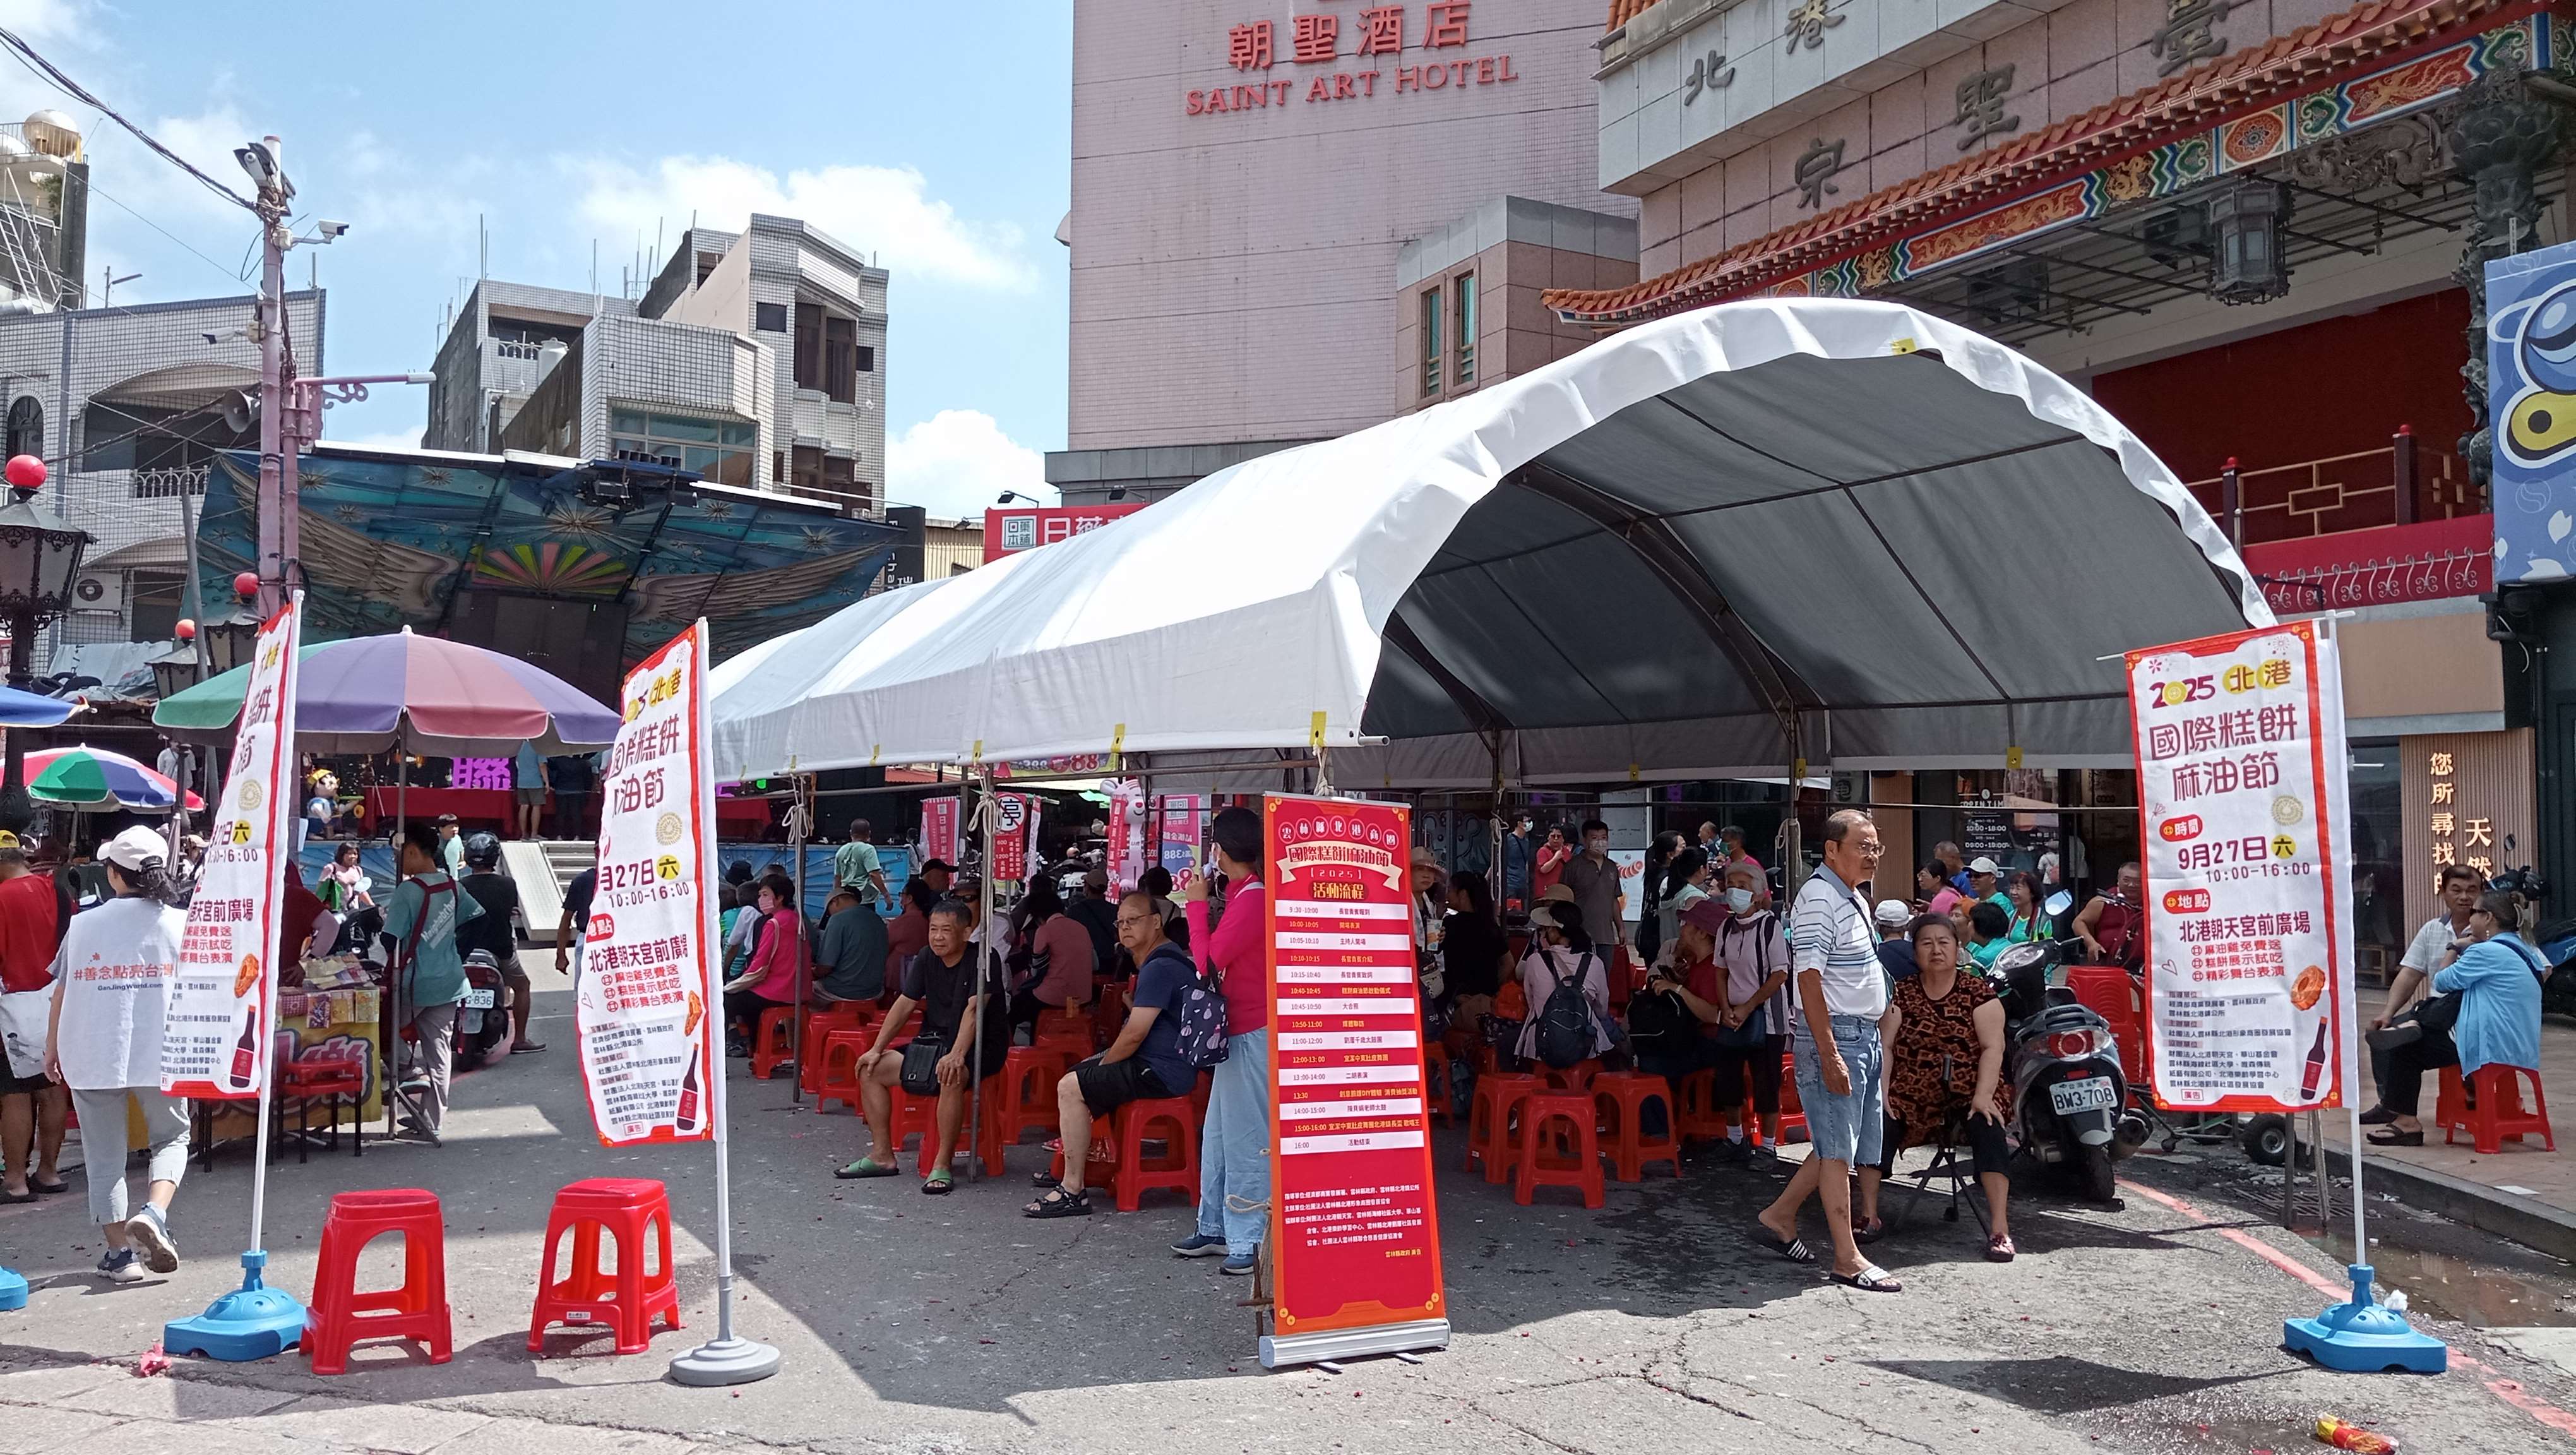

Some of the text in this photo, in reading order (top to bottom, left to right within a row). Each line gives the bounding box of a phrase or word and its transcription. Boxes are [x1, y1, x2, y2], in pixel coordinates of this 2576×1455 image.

[1228, 0, 1472, 71] 朝聖酒店
[1684, 0, 1846, 107] 北港
[1186, 54, 1519, 116] SAINT ART HOTEL
[2229, 660, 2292, 692] 北港
[2149, 704, 2298, 760] 國際糕餅
[2173, 751, 2279, 802] 麻油節
[612, 767, 665, 818] 油節
[2174, 820, 2200, 836] 時間
[2178, 836, 2294, 870] 9月27日 六
[600, 858, 655, 892] 月27日
[2205, 862, 2310, 883] 10:00-16:00
[608, 882, 689, 908] 10:00-16:00
[1313, 882, 1364, 900] 活動流程
[2177, 893, 2209, 909] 地點
[2179, 911, 2311, 943] 北港朝天宮前廣場
[2205, 939, 2282, 955] 麻油雞免費送
[2205, 952, 2284, 967] 糕餅展示試吃
[73, 963, 174, 981] #善念點亮台灣
[2206, 966, 2285, 982] 精彩舞台表演
[97, 983, 164, 991] GanJingWorld.com
[2184, 1091, 2201, 1099] 廣告
[1294, 1106, 1326, 1115] 14:00-15:00
[1294, 1124, 1327, 1132] 15:00-16:00
